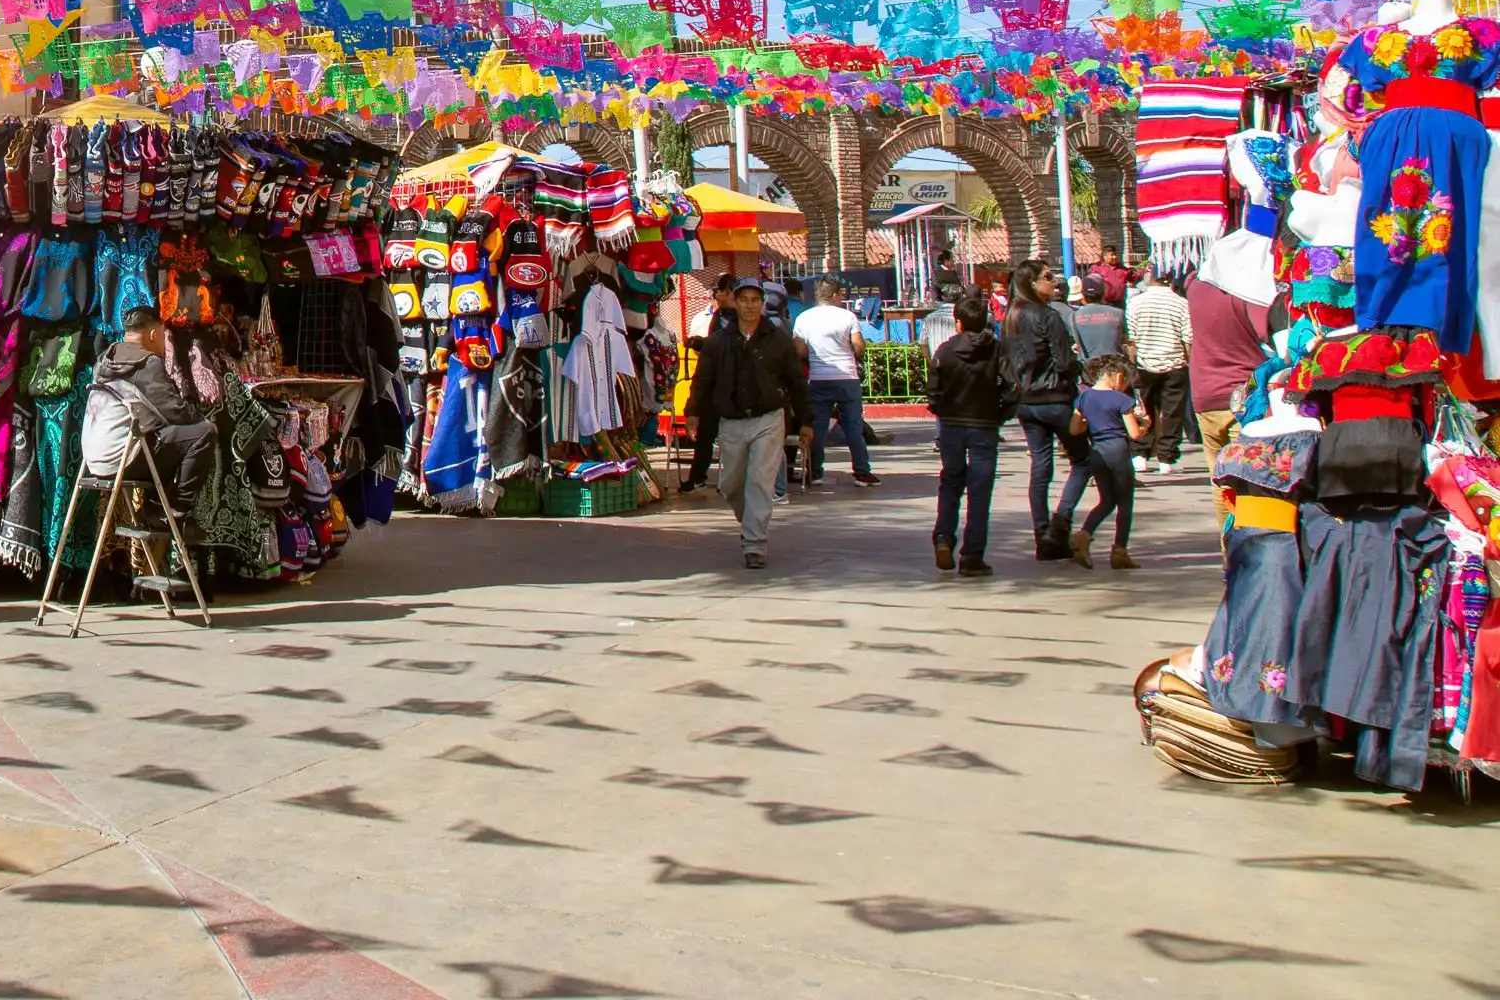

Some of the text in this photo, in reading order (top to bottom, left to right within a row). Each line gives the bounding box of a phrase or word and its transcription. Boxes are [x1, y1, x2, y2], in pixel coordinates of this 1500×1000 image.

[919, 184, 945, 192] BUD
[914, 190, 949, 199] LIGHT
[870, 201, 893, 209] LEGRE
